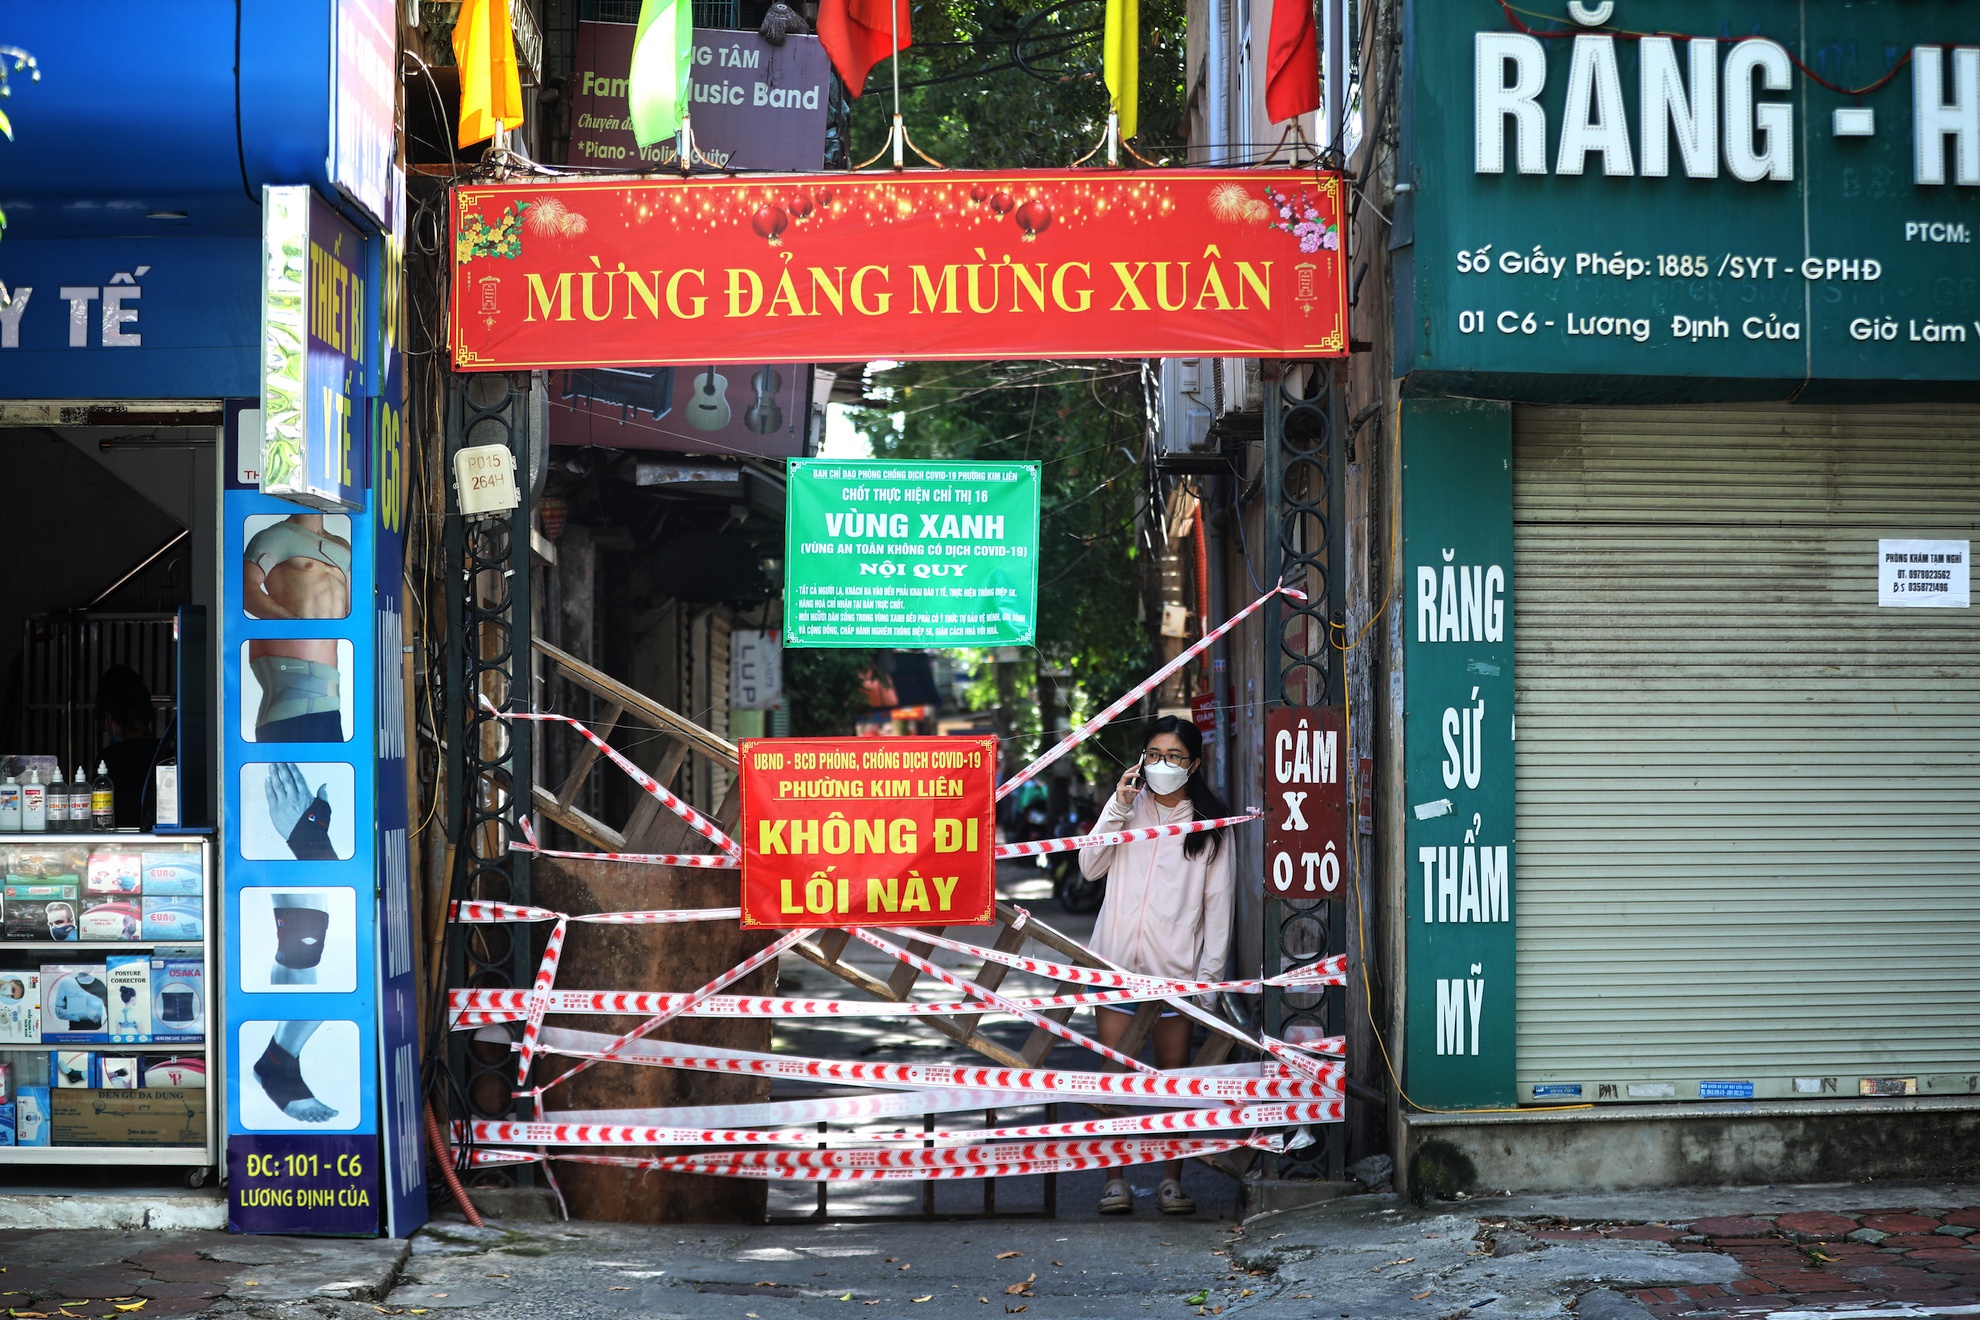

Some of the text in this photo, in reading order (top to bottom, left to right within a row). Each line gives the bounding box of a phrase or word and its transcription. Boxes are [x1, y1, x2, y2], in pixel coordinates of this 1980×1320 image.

[719, 44, 760, 68] TÂM
[753, 82, 819, 110] Band
[1475, 0, 1794, 183] RĂNG
[578, 113, 620, 133] Chuyên
[1905, 222, 1971, 243] PTCM:
[1457, 243, 1882, 281] Số Giấy Phép: 1885 /SYT GPHĐ
[523, 244, 1274, 322] MỪNG ĐẢNG MỪNG XUÂN
[60, 266, 152, 348] TẾ
[310, 233, 364, 386] THIẾT BỊ
[1458, 310, 1800, 342] 01 C6 Lương Định Của
[1849, 315, 1966, 342] Giờ Làm
[323, 370, 352, 487] Y TẾ
[381, 402, 400, 533] C6
[468, 453, 501, 471] P015
[813, 467, 1018, 481] BAN CHỈ ĐẠO PHÒNG CHỐNG DỊCH COVID-19 PHƯỜNG KIM LIÊN
[472, 472, 505, 491] 264H
[842, 484, 988, 505] CHỐT THỰC HIỆN CHỈ THỊ 16
[825, 508, 1004, 539] VÙNG XANH
[801, 542, 1027, 558] (VÙNG AN TOÀN KHÔNG CÓ DỊCH COVID-19)
[1885, 552, 1962, 566] PHÒNG KHÁM TẠM NGHỈ
[860, 560, 968, 579] NỘI QUY
[1908, 570, 1951, 579] 0978023562
[1417, 547, 1504, 644] RĂNG
[1441, 685, 1486, 791] SỨ
[754, 746, 981, 772] UBND BCĐ PHÒNG, CHỐNG DỊCH COVID-19
[779, 776, 963, 798] PHƯỜNG KIM LIÊN
[1281, 791, 1309, 831] X
[759, 811, 978, 855] KHÔNG ĐI
[1273, 840, 1341, 892] O TÔ
[1419, 812, 1510, 924] THẨM
[780, 866, 959, 914] LỐI NÀY
[169, 969, 201, 977] OSAKA
[1436, 963, 1485, 1056] MỸ
[246, 1153, 362, 1178] ĐC: 101 C6
[240, 1184, 370, 1211] LƯƠNG ĐỊNH CỦA
